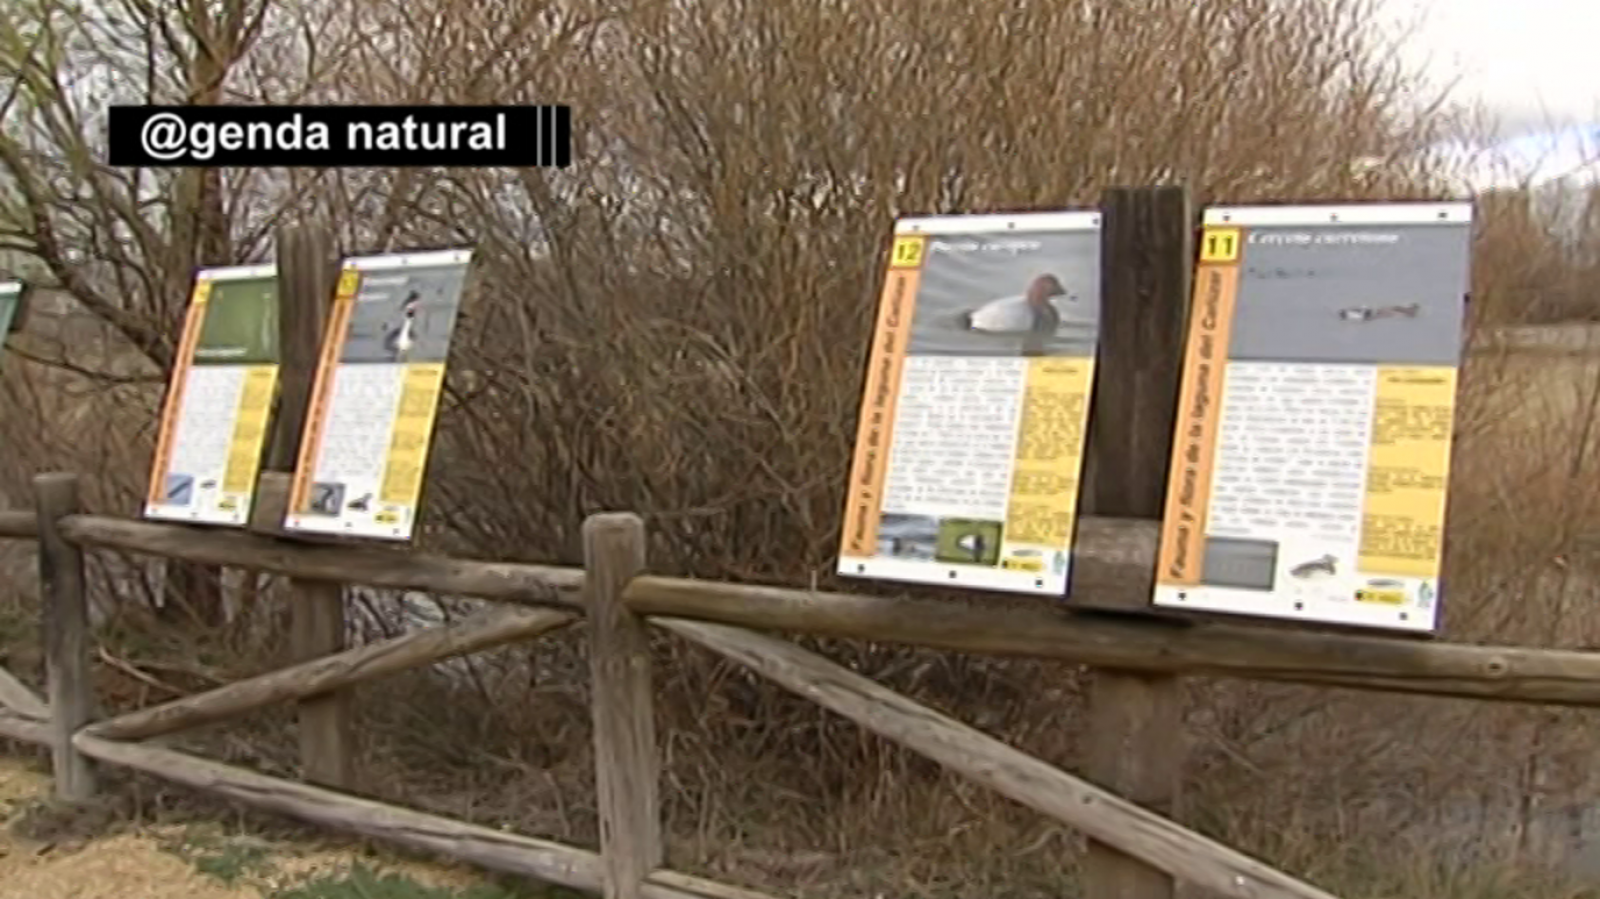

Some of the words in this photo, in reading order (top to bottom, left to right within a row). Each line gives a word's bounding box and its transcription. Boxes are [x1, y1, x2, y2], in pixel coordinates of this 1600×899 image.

[897, 241, 922, 261] 12
[1207, 235, 1233, 255] 11
[1199, 335, 1213, 359] del
[1186, 443, 1199, 463] de
[1180, 510, 1195, 523] y
[1169, 526, 1189, 579] Fauna
